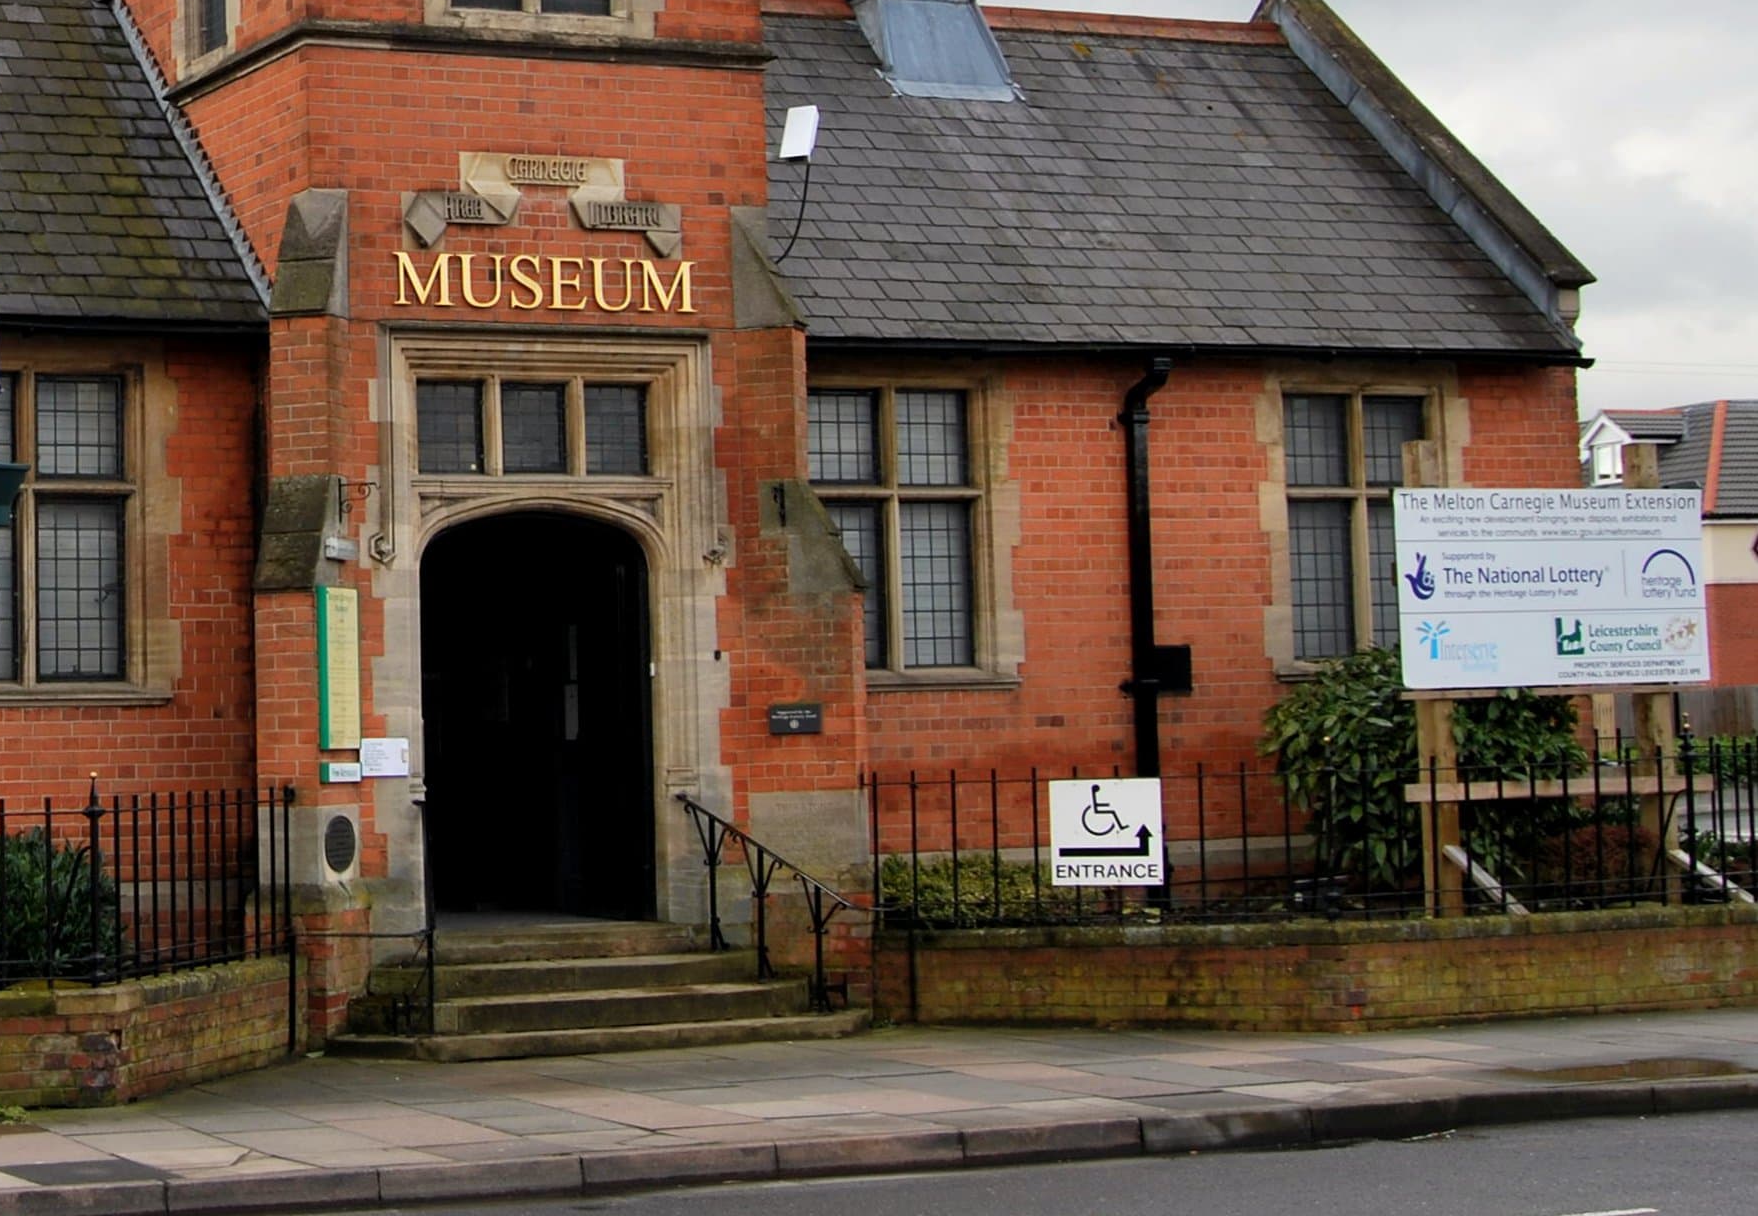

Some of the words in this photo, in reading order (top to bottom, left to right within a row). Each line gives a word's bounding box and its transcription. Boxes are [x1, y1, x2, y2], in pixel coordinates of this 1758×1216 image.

[506, 156, 589, 182] CARNEGIE
[392, 251, 699, 313] MUSEUM
[1400, 492, 1428, 510] The
[1433, 492, 1484, 510] Melton
[1490, 492, 1555, 514] Carnegie
[1559, 493, 1621, 510] Museum
[1625, 492, 1696, 510] Extension
[1484, 515, 1534, 525] development
[1442, 551, 1484, 562] Supported
[1486, 551, 1496, 562] by
[1443, 567, 1473, 584] The
[1478, 566, 1545, 584] National
[1550, 565, 1603, 587] Lottery
[1444, 589, 1476, 600] through
[1478, 589, 1491, 598] the
[1494, 588, 1527, 599] Heritage
[1529, 588, 1556, 599] Lottery
[1558, 587, 1578, 597] Fund
[1588, 623, 1659, 638] Leicestershire
[1589, 640, 1623, 653] County
[1626, 639, 1662, 652] Council
[1055, 863, 1160, 880] ENTRANCE
